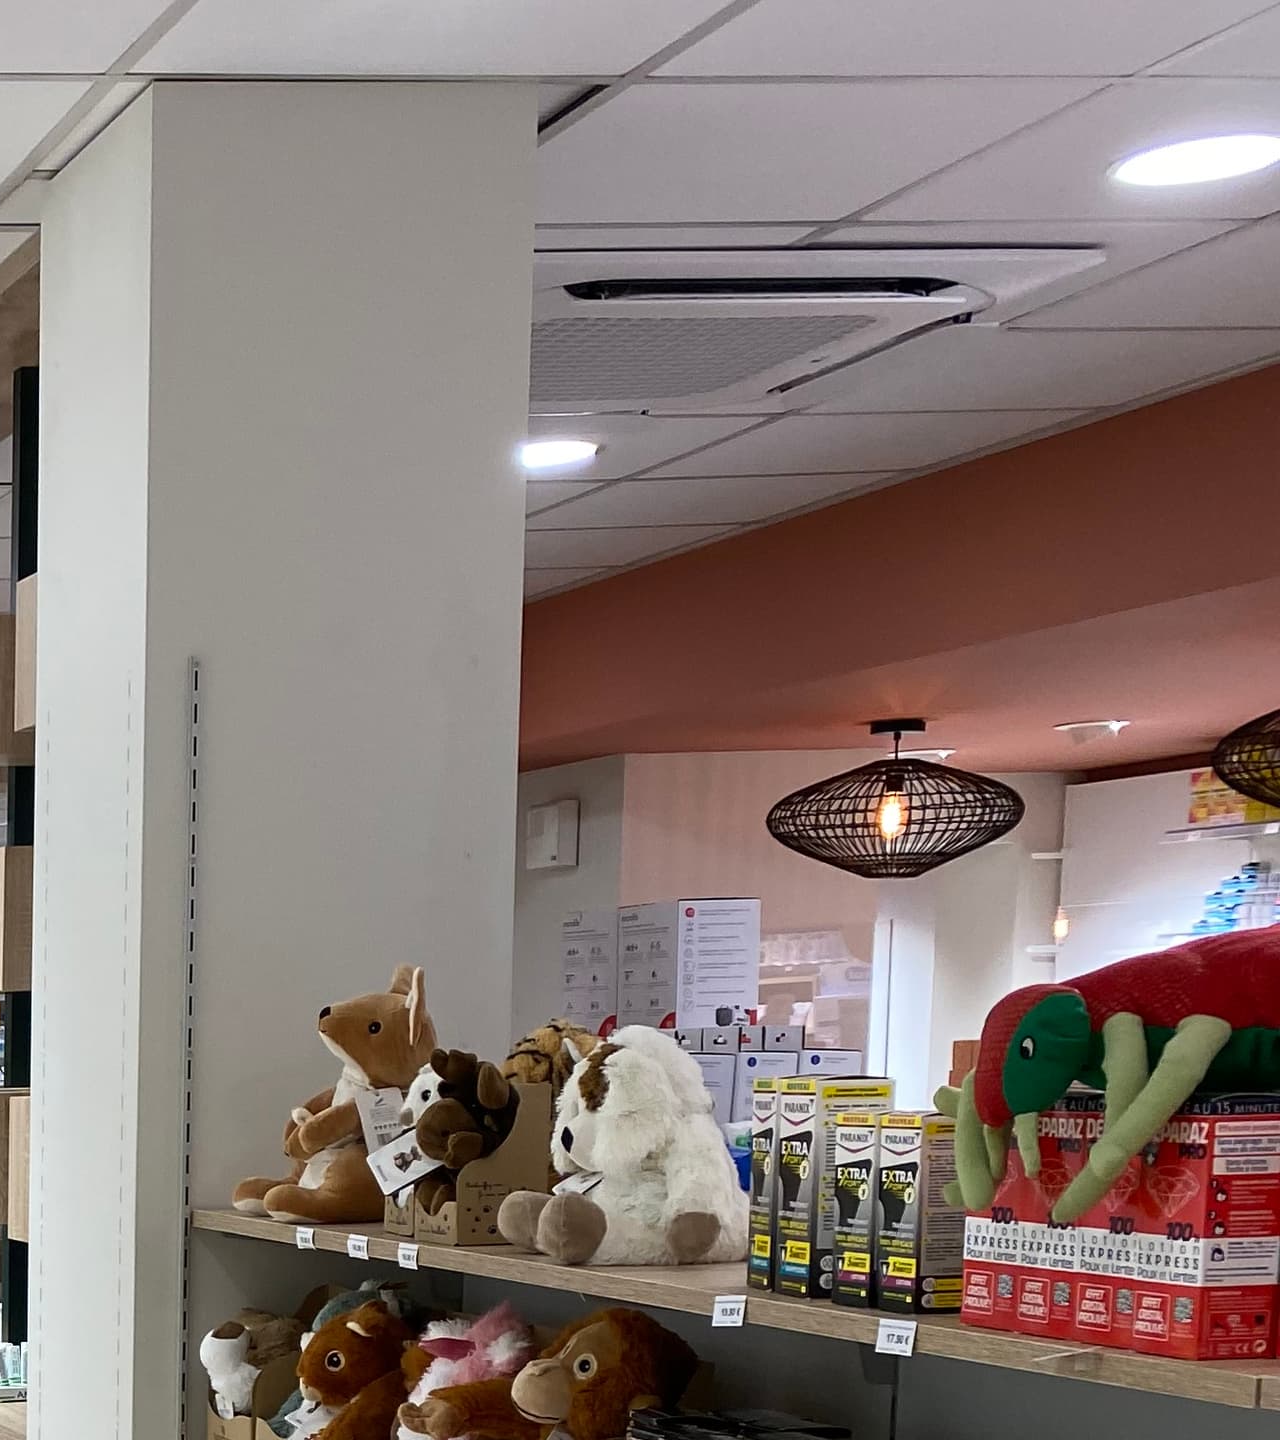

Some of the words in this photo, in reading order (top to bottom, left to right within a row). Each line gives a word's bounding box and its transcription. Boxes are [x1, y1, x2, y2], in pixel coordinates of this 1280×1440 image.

[1217, 1101, 1231, 1115] 15
[840, 1131, 870, 1143] PARANIX
[885, 1132, 917, 1145] PARANIX
[781, 1140, 809, 1155] EXTRA
[1180, 1144, 1207, 1159] PRO
[837, 1167, 868, 1181] EXTRA
[882, 1169, 914, 1183] EXTRA
[967, 1222, 1019, 1237] Lotion
[1022, 1226, 1076, 1243] Lotion
[967, 1234, 1018, 1250] EXPRESS
[1021, 1239, 1076, 1257] EXPRESS
[1139, 1238, 1201, 1256] Lotion
[966, 1249, 984, 1259] Poux
[1021, 1253, 1039, 1266] Poux
[1138, 1249, 1200, 1271] EXPRESS
[1080, 1259, 1102, 1272] Poux
[1137, 1267, 1158, 1279] Poux
